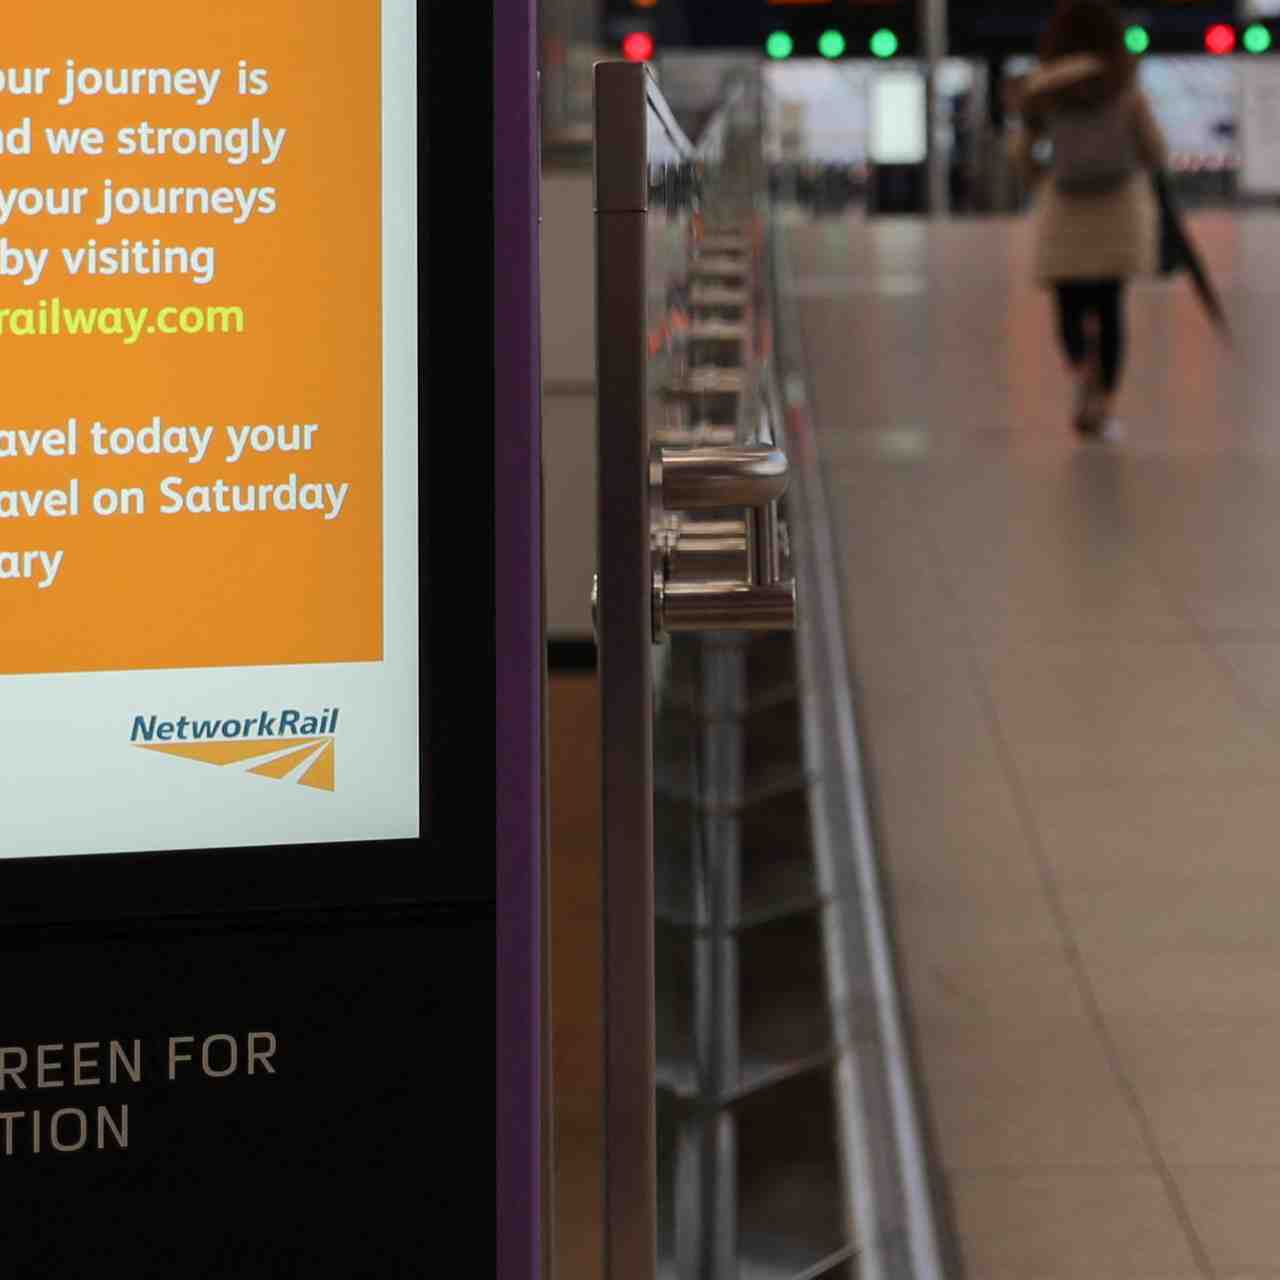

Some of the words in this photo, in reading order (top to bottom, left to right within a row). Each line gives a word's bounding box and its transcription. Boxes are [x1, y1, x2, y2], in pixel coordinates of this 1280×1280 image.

[57, 59, 222, 107] journey
[238, 59, 269, 96] is
[44, 127, 105, 156] we
[117, 117, 287, 166] strongly
[95, 178, 277, 225] journeys
[0, 237, 50, 286] by
[61, 238, 215, 285] visiting
[90, 415, 214, 465] today
[225, 423, 319, 464] your
[92, 487, 145, 516] on
[159, 473, 349, 520] Saturday
[169, 1032, 276, 1079] FOR
